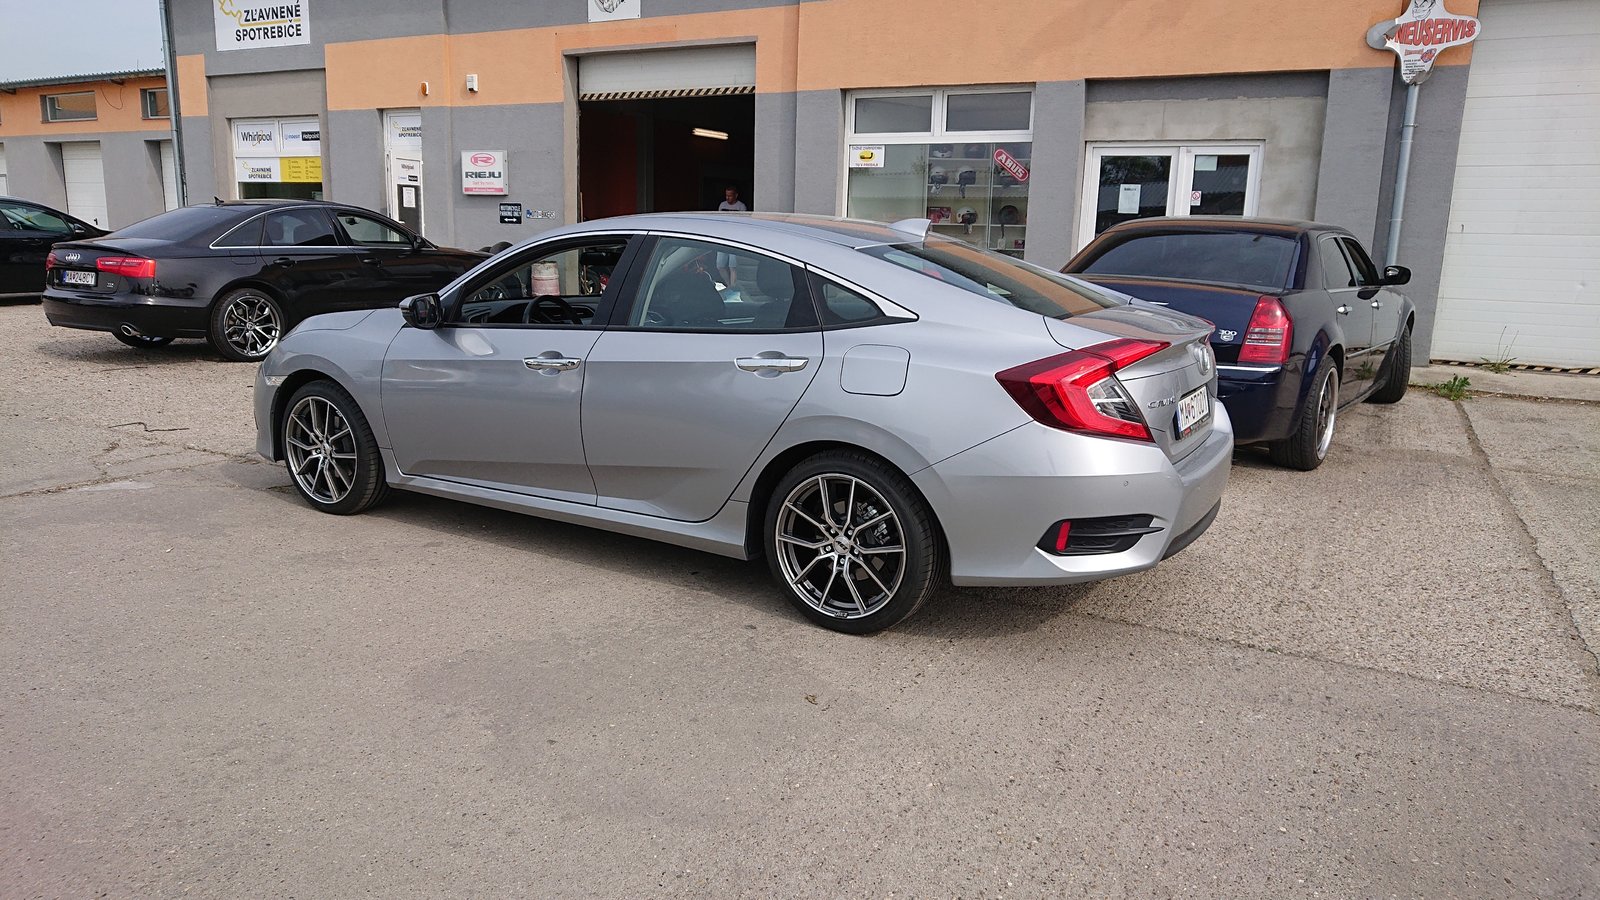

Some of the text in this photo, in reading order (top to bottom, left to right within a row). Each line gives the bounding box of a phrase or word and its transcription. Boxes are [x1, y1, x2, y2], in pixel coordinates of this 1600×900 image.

[243, 0, 301, 22] ZĽAVNENÉ
[235, 20, 302, 42] SPOTREBIČE
[1393, 18, 1477, 46] NEUSERVIS
[241, 130, 272, 144] Whirlpool
[465, 171, 502, 179] RIEJU
[997, 153, 1025, 179] ABUS
